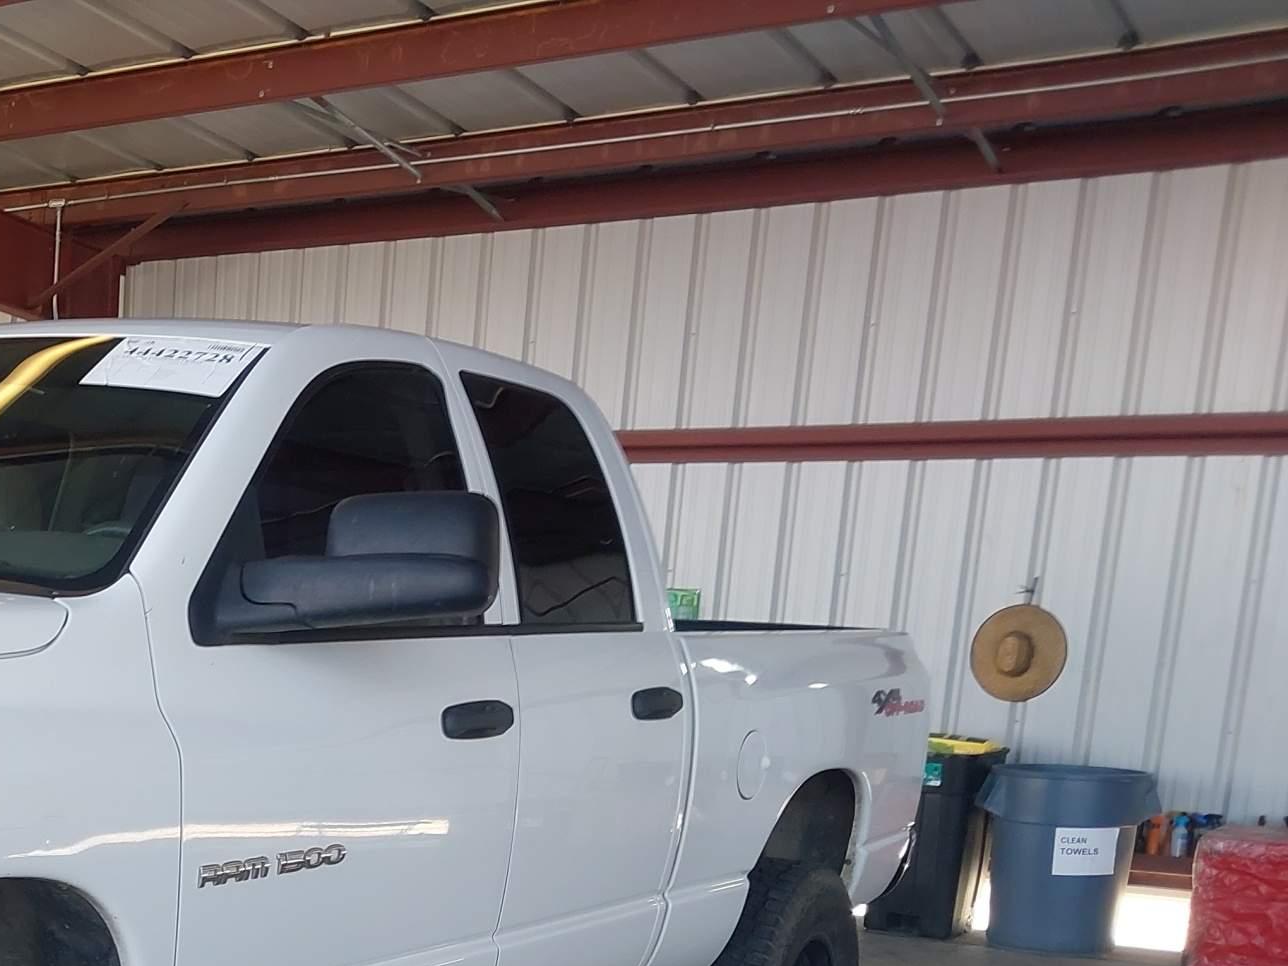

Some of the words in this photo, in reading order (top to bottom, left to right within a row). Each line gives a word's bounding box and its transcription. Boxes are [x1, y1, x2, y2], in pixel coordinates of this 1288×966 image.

[124, 346, 235, 364] 44422728
[1060, 836, 1088, 845] CLEAN
[1060, 847, 1100, 856] TOWELS
[196, 855, 270, 889] RAM
[275, 843, 347, 876] 1500
